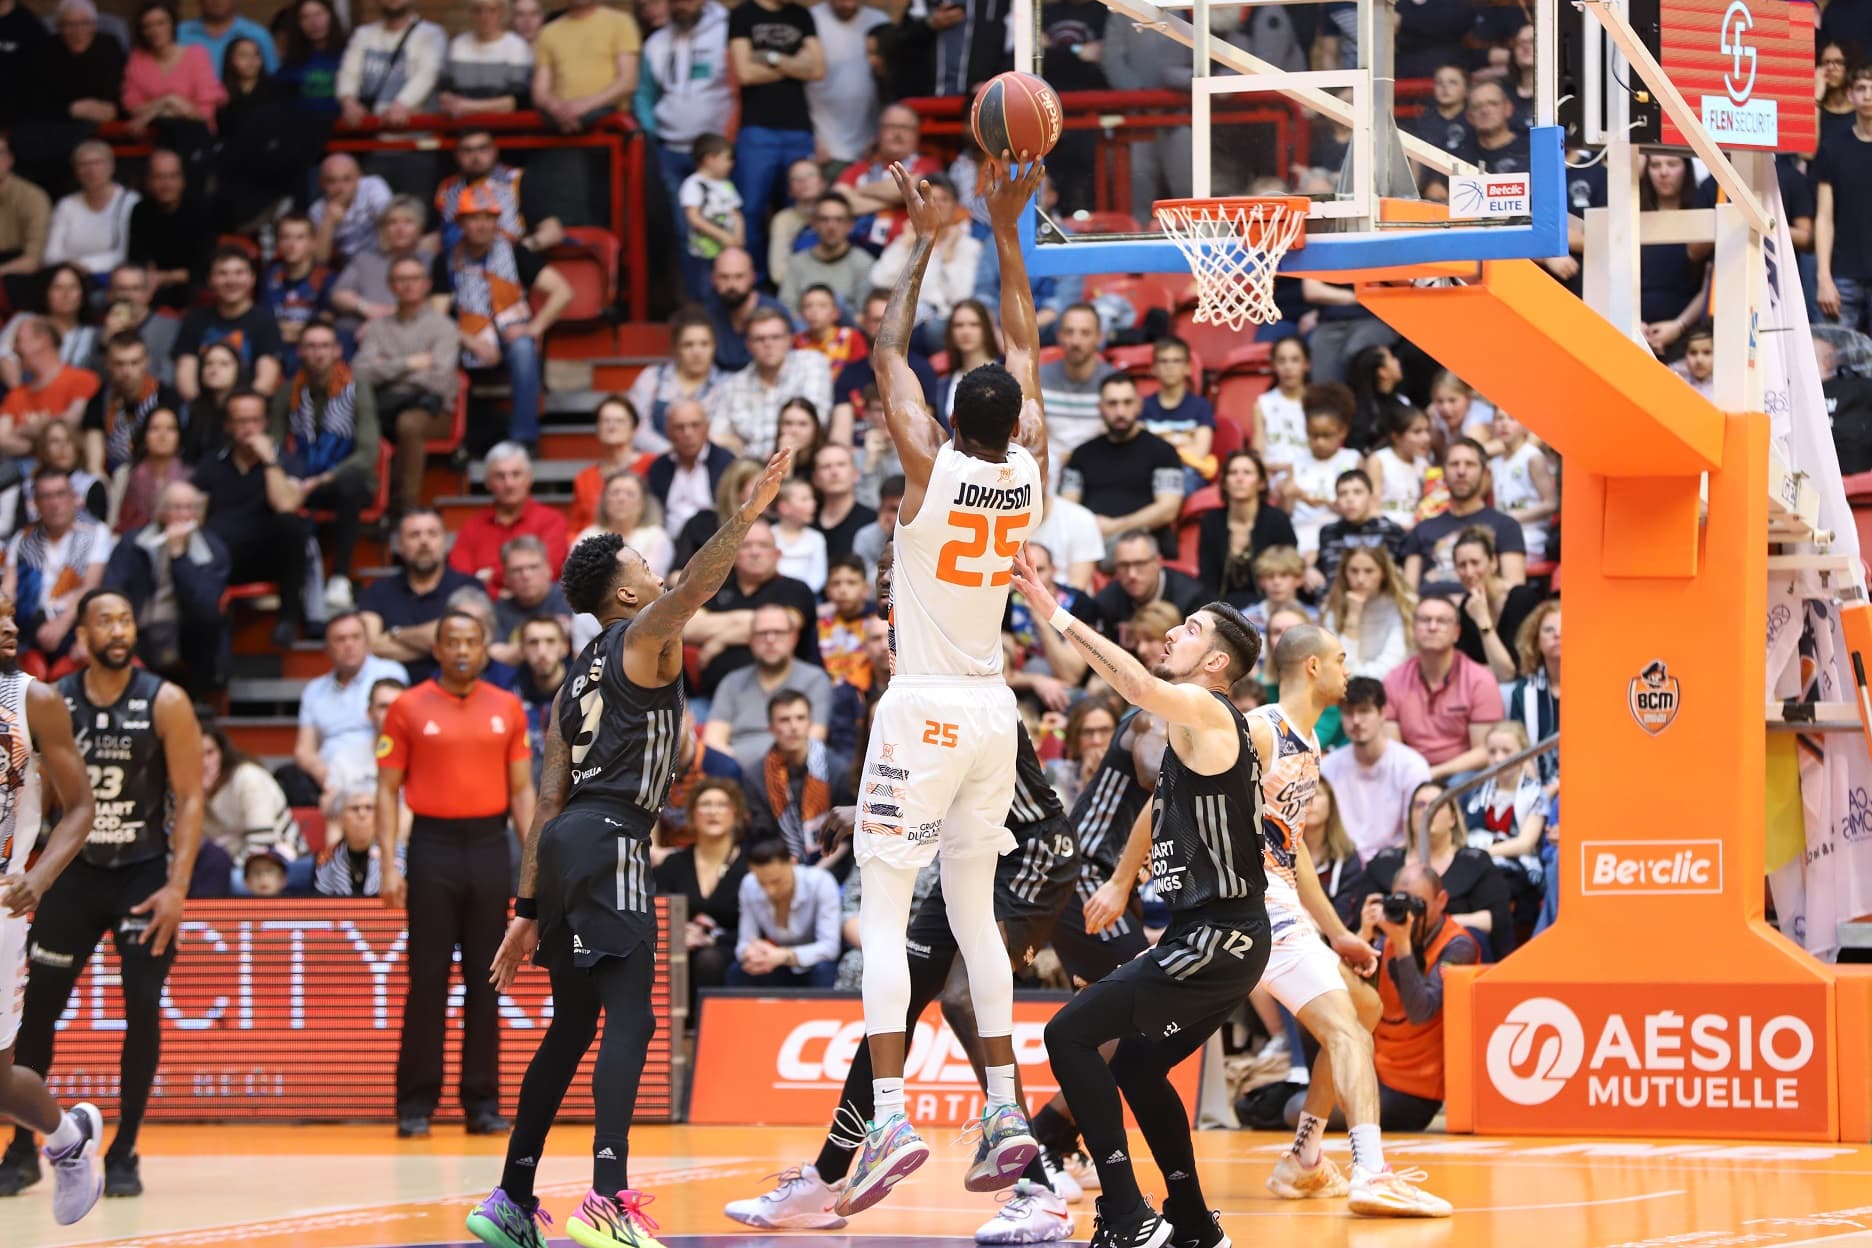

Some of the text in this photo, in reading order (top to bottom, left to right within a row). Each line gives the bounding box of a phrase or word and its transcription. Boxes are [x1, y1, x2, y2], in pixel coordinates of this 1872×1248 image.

[1040, 91, 1060, 143] Betclic
[1710, 109, 1734, 131] FLEN
[1488, 183, 1524, 196] Betclic
[1489, 198, 1523, 212] ÉLITE
[953, 482, 1031, 510] JOHNSON
[936, 510, 1031, 588] 25
[1637, 692, 1674, 709] BCM
[922, 719, 960, 749] 25
[1053, 834, 1074, 857] 19
[1222, 929, 1254, 960] 12
[1589, 1010, 1815, 1073] AÉSIO
[1588, 1075, 1799, 1109] MUTUELLE
